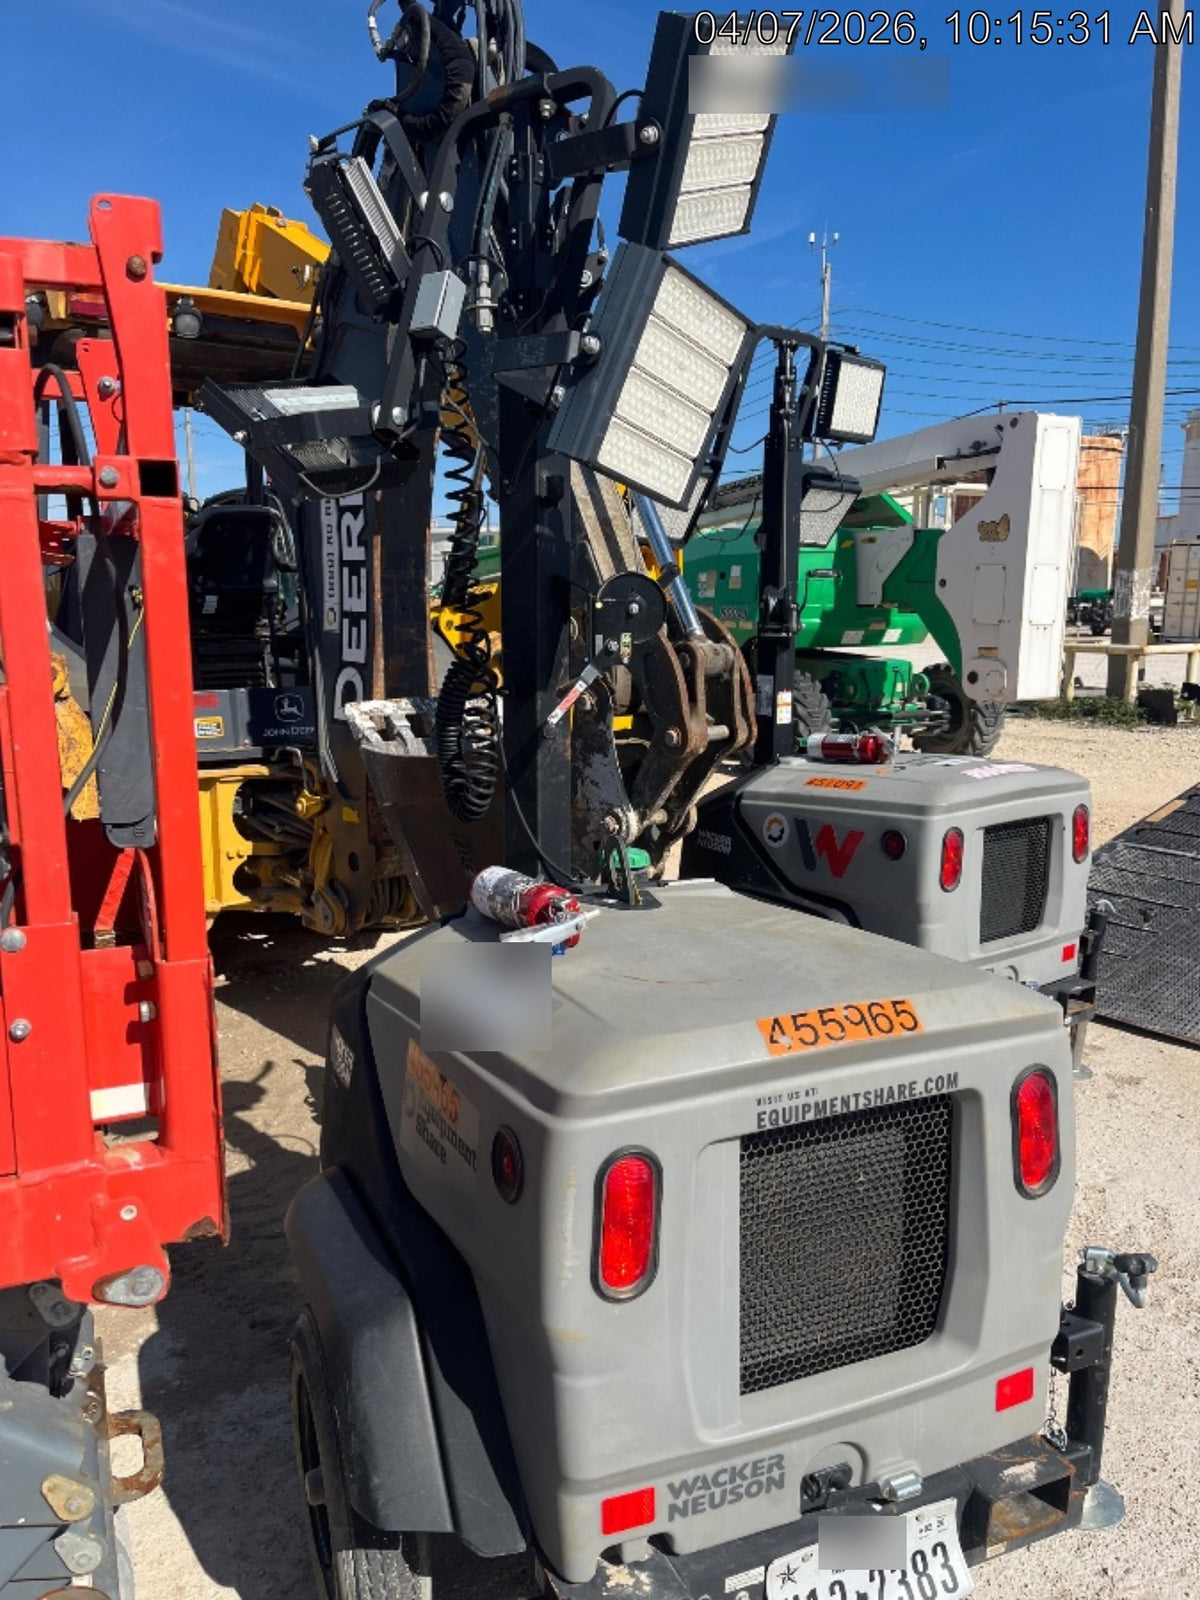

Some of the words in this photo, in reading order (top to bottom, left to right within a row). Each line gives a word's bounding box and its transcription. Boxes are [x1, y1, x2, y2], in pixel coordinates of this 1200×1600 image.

[769, 1000, 918, 1049] 455965
[756, 1092, 785, 1106] VISIT
[788, 1090, 800, 1101] US
[757, 1072, 959, 1129] EQUIPMENTSHARE.COM
[667, 1453, 786, 1500] WACKER
[667, 1471, 786, 1523] NEUSON
